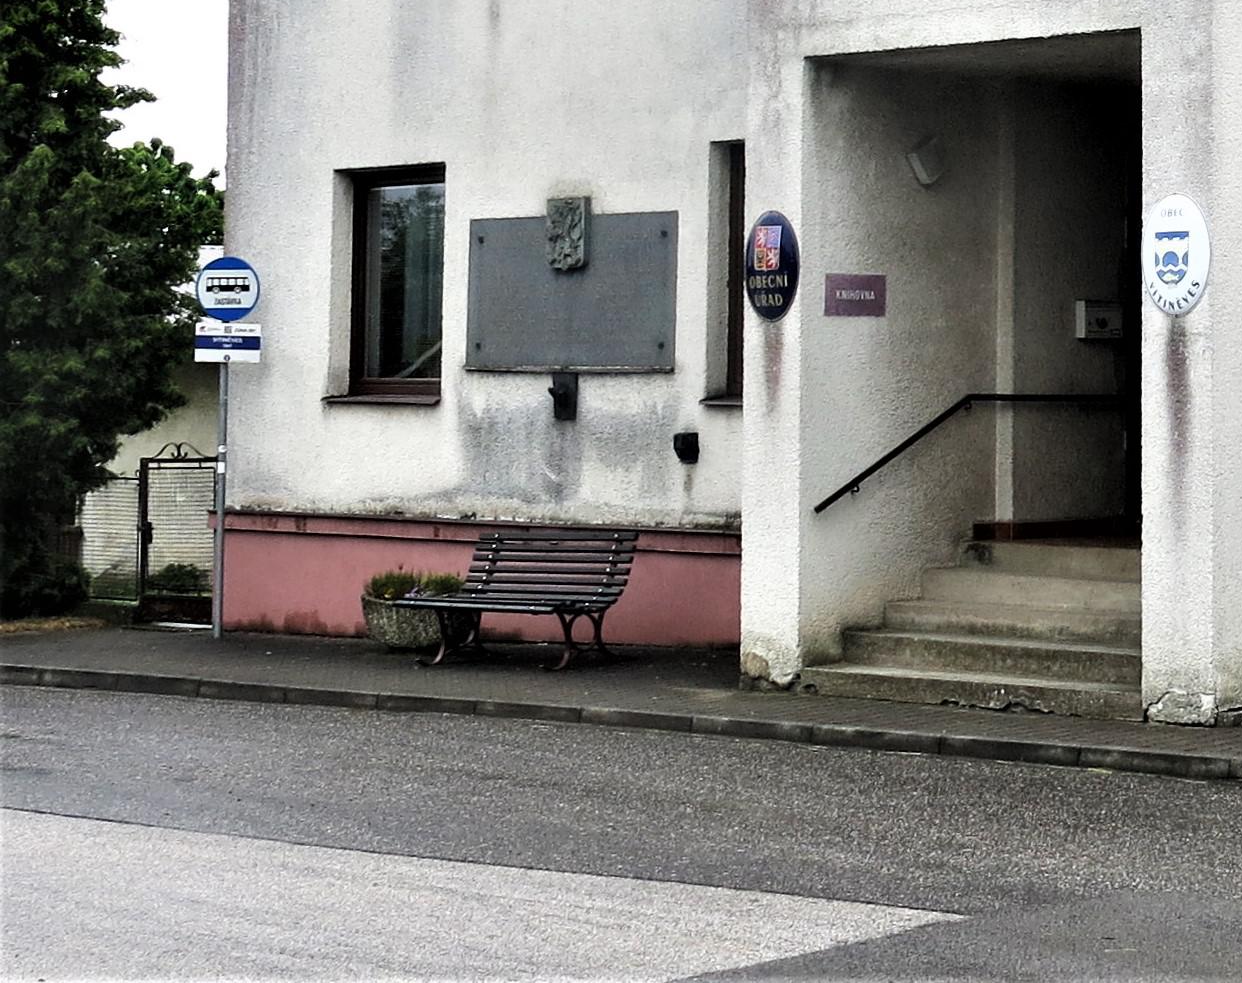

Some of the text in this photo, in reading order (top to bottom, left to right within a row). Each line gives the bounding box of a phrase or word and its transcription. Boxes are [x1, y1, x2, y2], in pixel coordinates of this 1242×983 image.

[1161, 208, 1184, 217] OBEC
[749, 273, 788, 288] OBECNÍ
[754, 291, 783, 307] ÚŘAD
[836, 290, 875, 300] KNIHOVNA
